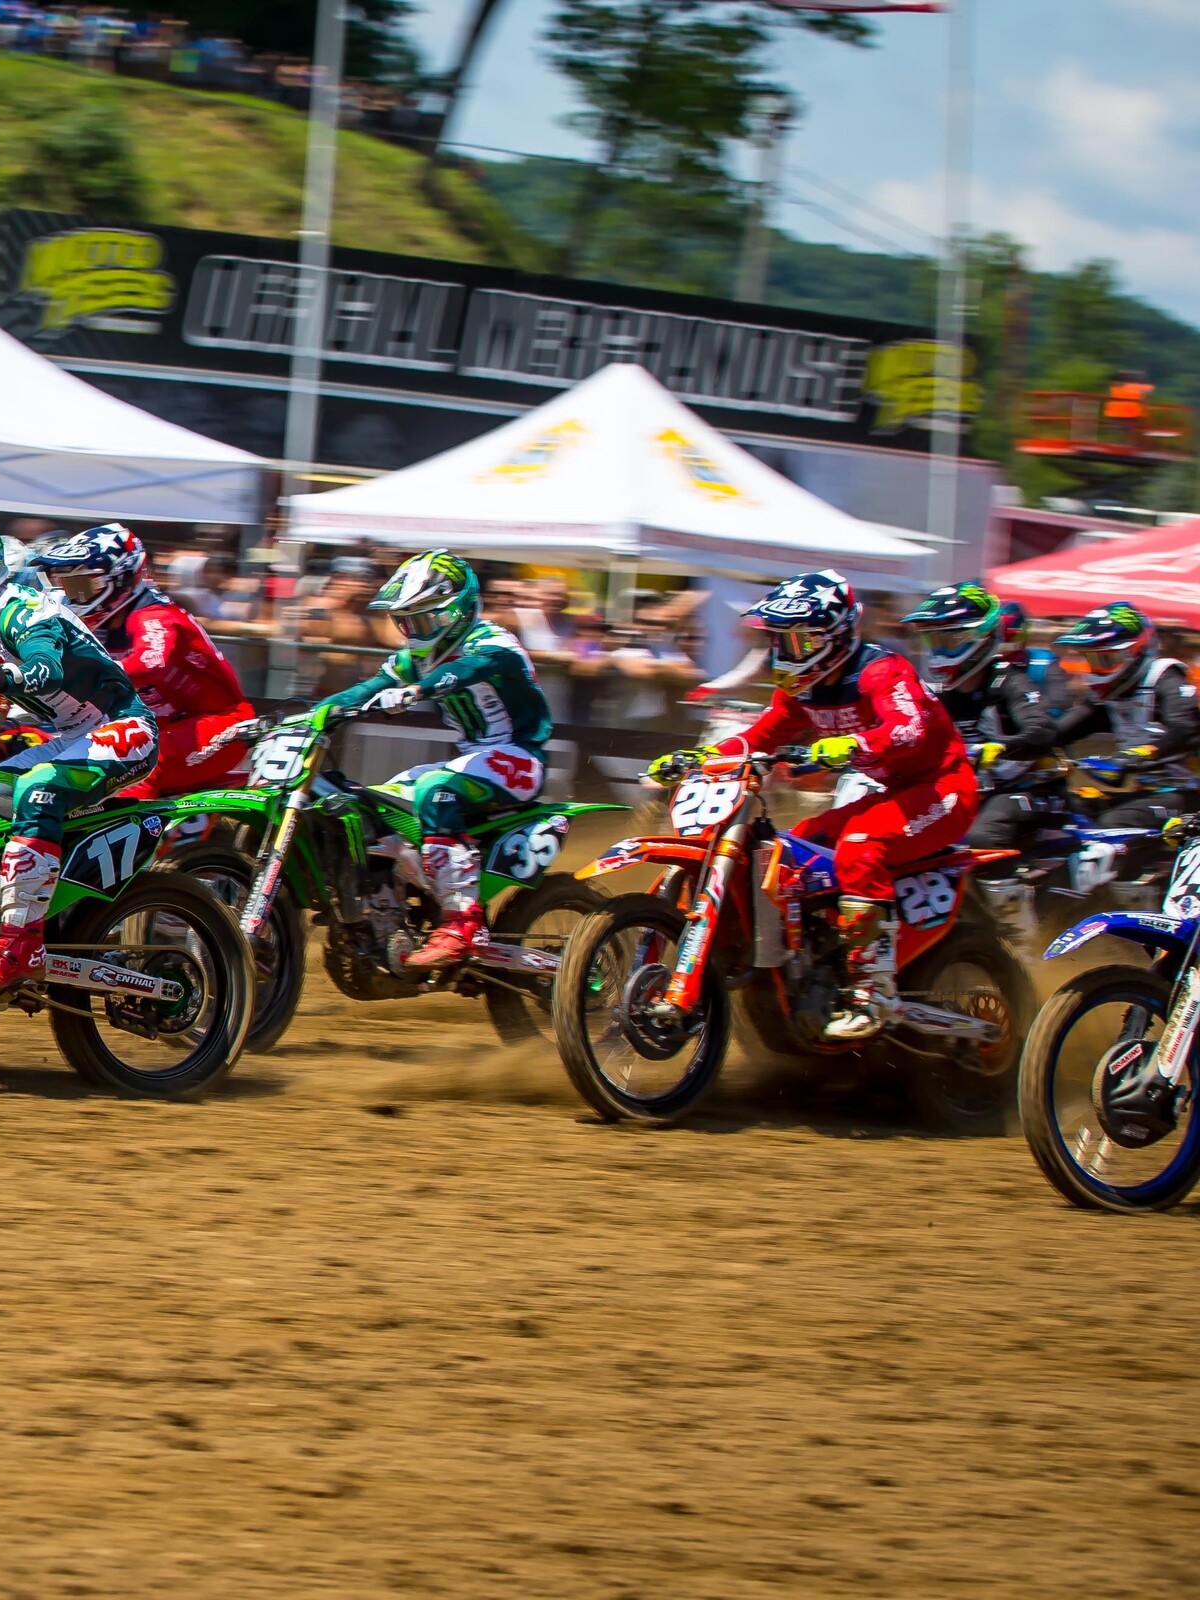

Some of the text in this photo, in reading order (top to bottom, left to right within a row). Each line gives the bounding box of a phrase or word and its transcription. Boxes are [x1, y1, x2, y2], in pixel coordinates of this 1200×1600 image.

[28, 790, 57, 805] FOX
[670, 780, 743, 827] 28
[68, 805, 105, 820] Kawasaki
[86, 822, 141, 890] 17
[503, 824, 561, 880] 35
[894, 871, 958, 926] 28
[50, 969, 81, 979] BRAKING
[52, 958, 70, 970] RK
[1111, 1046, 1143, 1073] BRAKING
